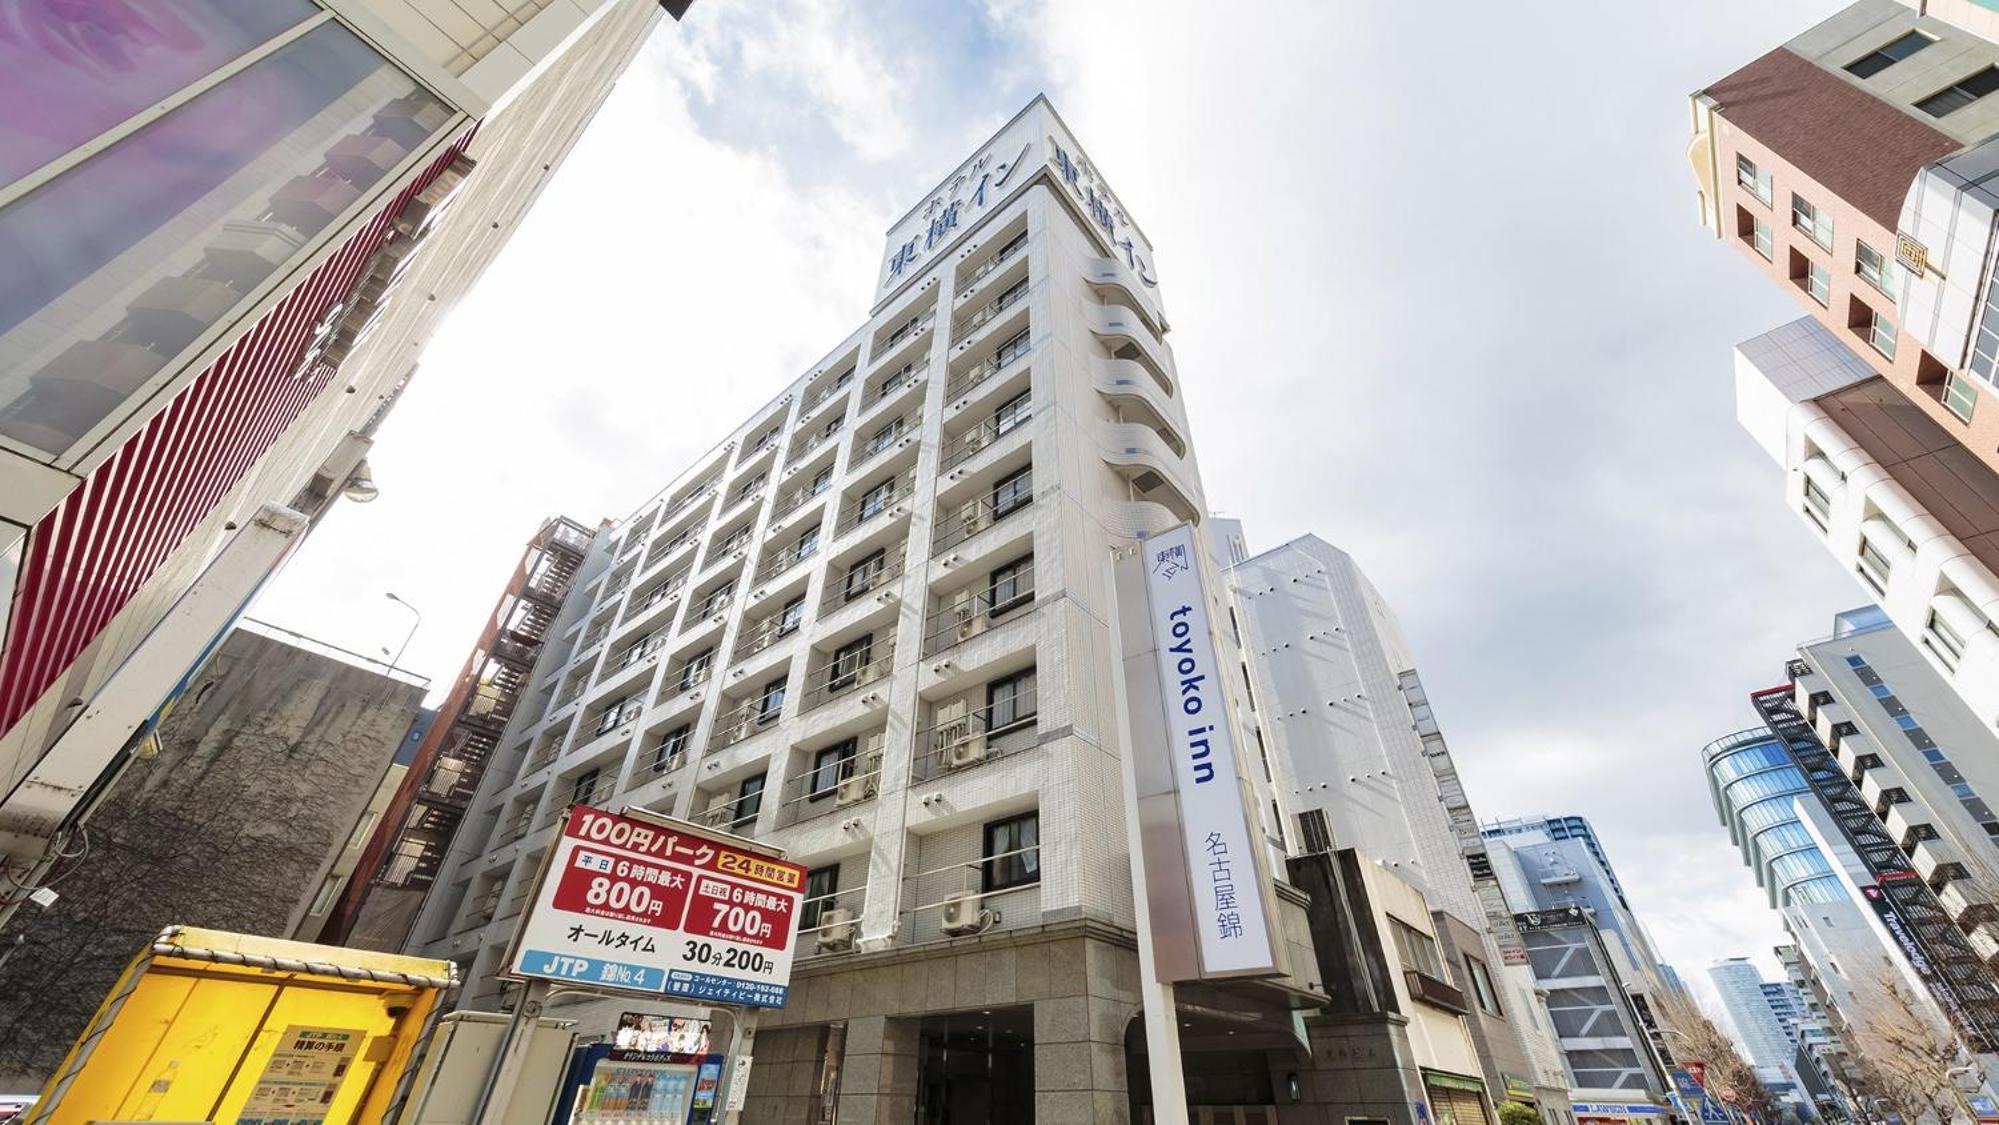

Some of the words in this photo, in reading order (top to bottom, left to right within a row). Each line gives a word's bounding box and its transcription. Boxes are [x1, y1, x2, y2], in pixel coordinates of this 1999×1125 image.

[883, 142, 1031, 288] 東横イン
[1169, 605, 1205, 716] toyoko
[1188, 724, 1215, 784] inn
[578, 813, 715, 866] 100円パーク
[616, 860, 686, 890] 6時間最大
[721, 854, 796, 884] 24時間営業
[1205, 831, 1243, 940] 名古屋錦
[586, 876, 664, 917] 800円
[732, 887, 788, 913] 6時間最大
[567, 924, 655, 953] オールタイム
[711, 901, 772, 938] 700円
[1883, 910, 1932, 975] Travelodge
[543, 955, 589, 977] JTP
